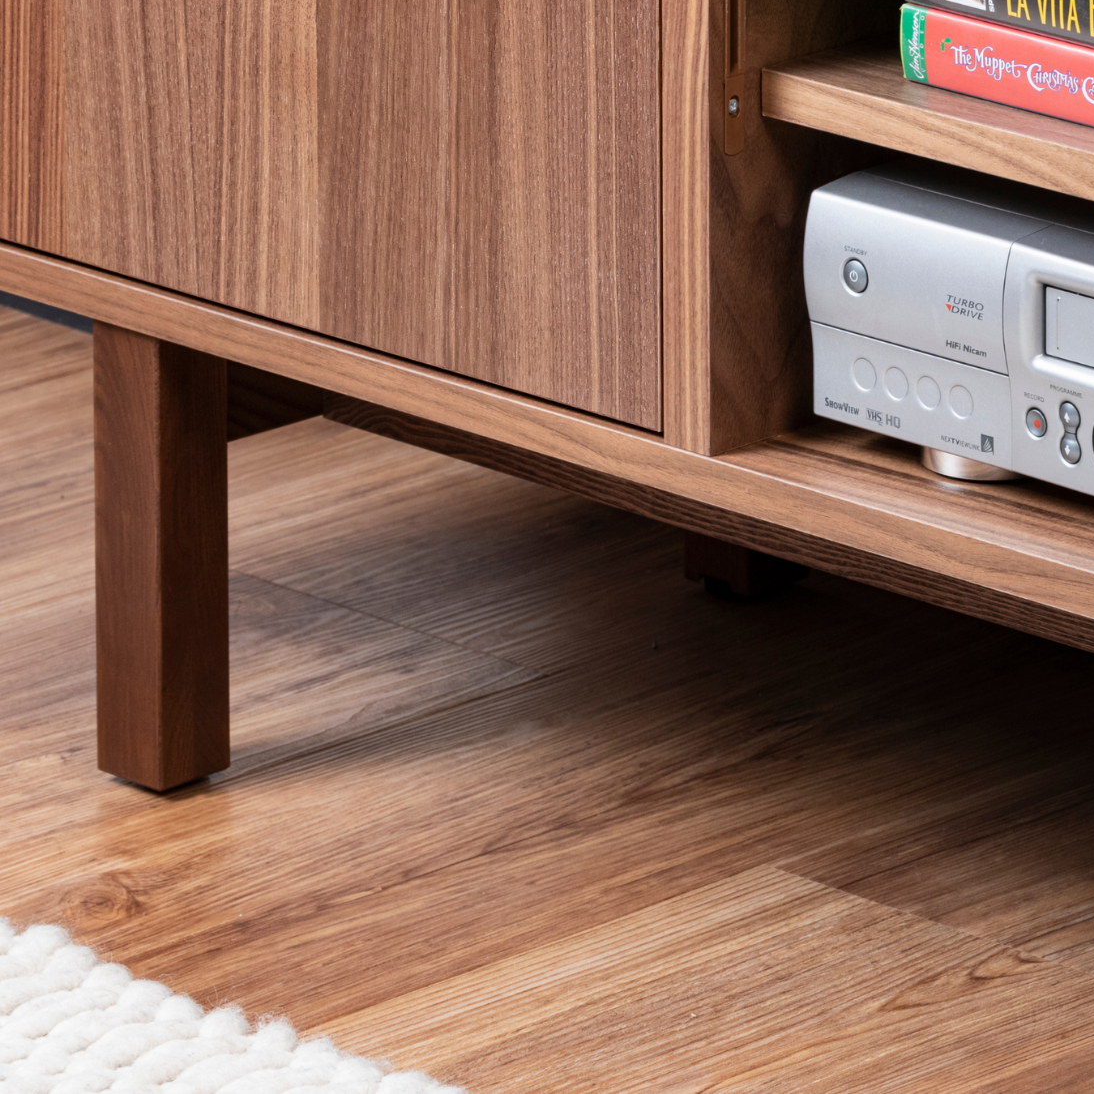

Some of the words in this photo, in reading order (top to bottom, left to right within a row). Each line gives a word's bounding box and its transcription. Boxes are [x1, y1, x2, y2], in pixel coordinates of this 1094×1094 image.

[908, 10, 920, 58] Henson
[908, 55, 925, 79] Jim
[965, 46, 1028, 81] Muppet
[843, 245, 868, 256] STANDBY
[947, 294, 984, 311] TURBO
[951, 305, 984, 321] DRIVE
[945, 339, 961, 351] HiFi
[963, 344, 987, 358] Nicam
[1023, 391, 1045, 403] RECORD
[1049, 384, 1083, 399] PROGRAMME
[866, 408, 883, 423] VHS
